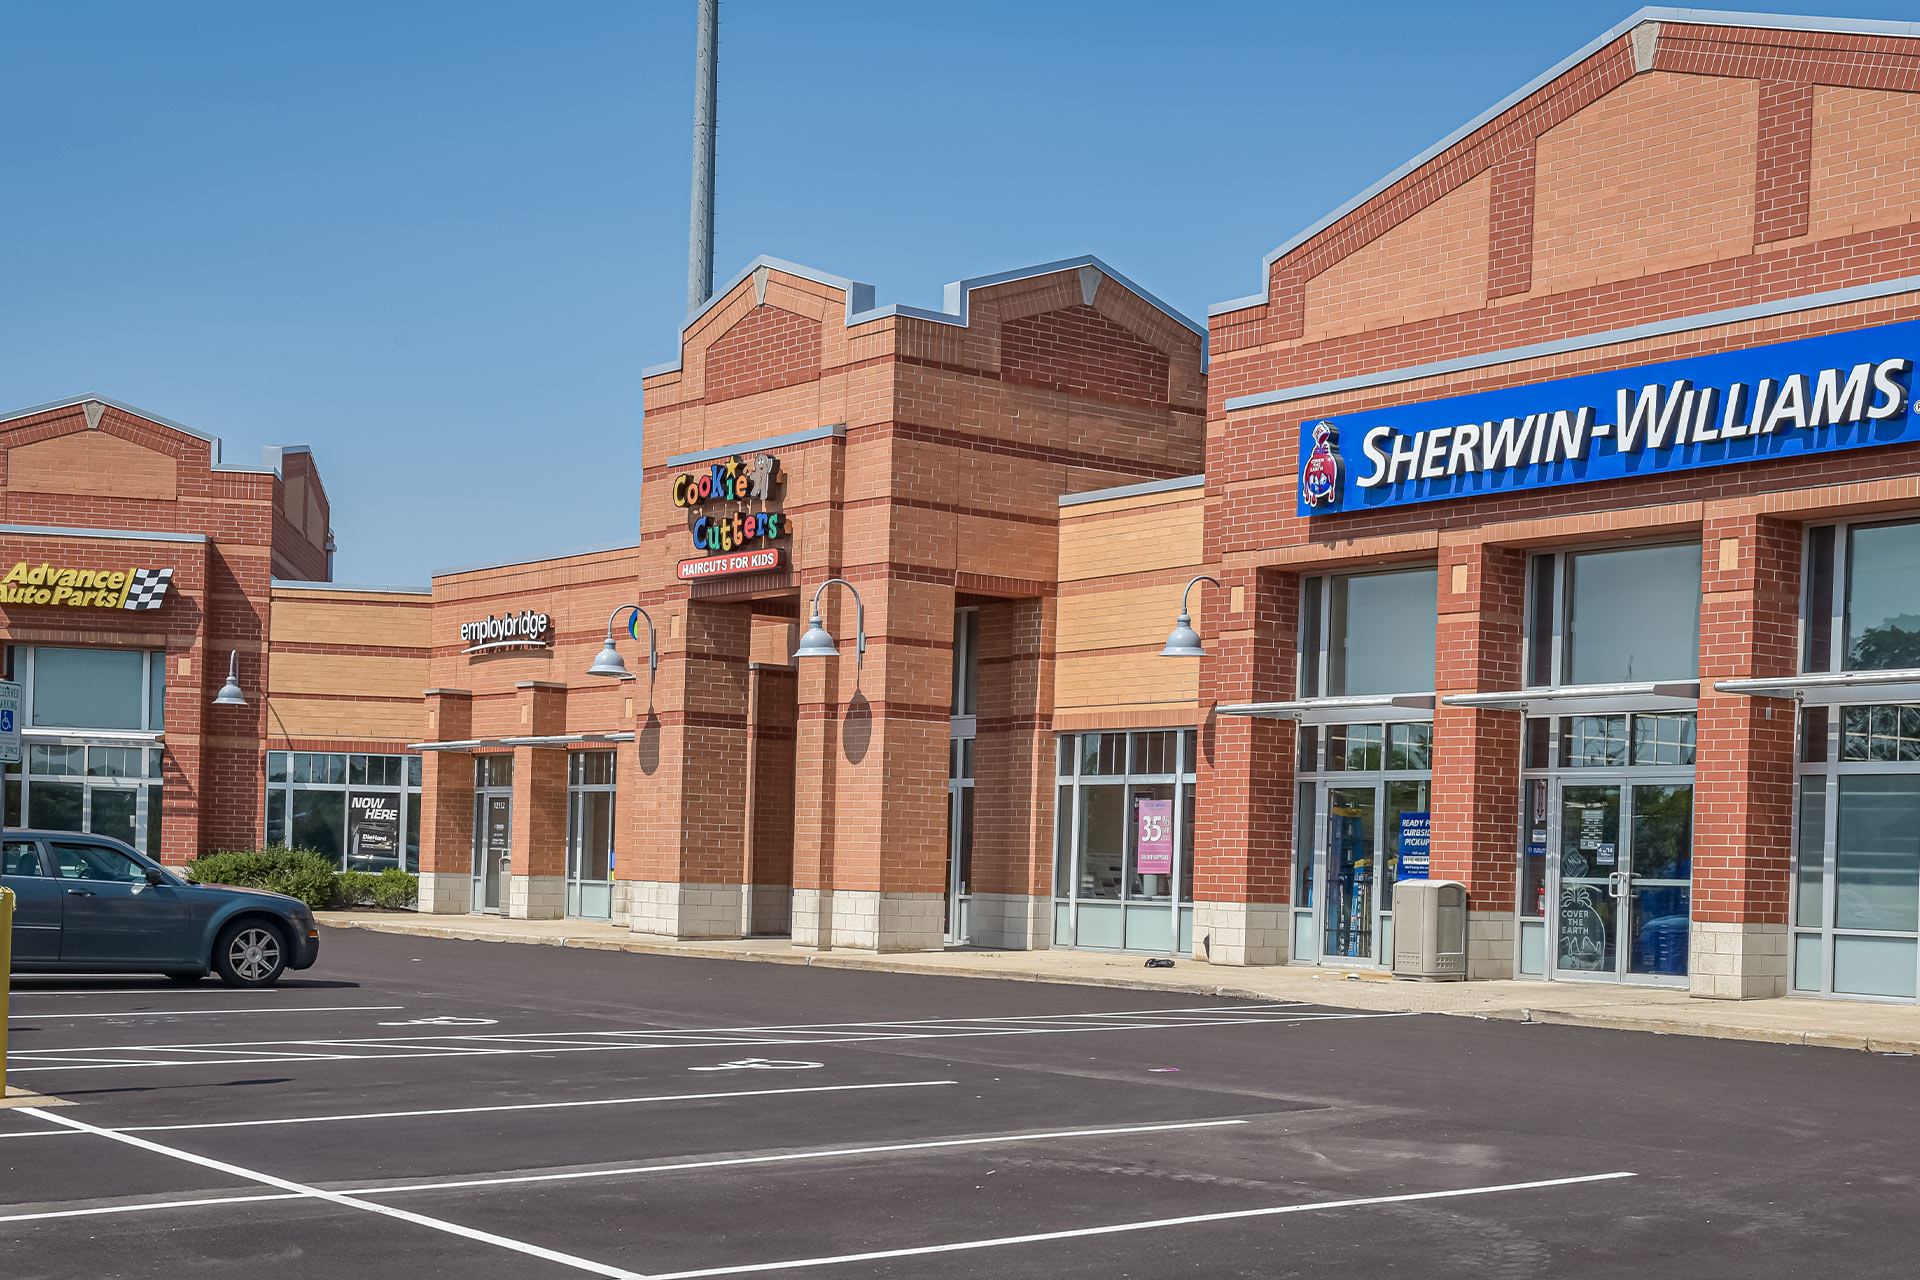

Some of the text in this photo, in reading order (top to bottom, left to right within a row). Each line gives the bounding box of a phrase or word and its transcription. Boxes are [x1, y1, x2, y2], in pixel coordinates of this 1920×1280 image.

[1356, 358, 1905, 488] SHERWIN-WILLIAMS
[673, 457, 748, 507] Cookie
[694, 512, 778, 551] Cutters
[2, 562, 126, 589] Advance
[682, 553, 775, 577] HAIRCUTS FOR KIDS
[51, 586, 119, 608] Parts
[461, 609, 547, 645] employbridge
[351, 797, 385, 808] NOW
[365, 808, 398, 820] HERE
[1142, 815, 1161, 842] 35
[1402, 819, 1424, 827] READY
[1561, 910, 1589, 918] COVER
[1568, 918, 1583, 926] THE
[1561, 926, 1589, 935] EARTH
